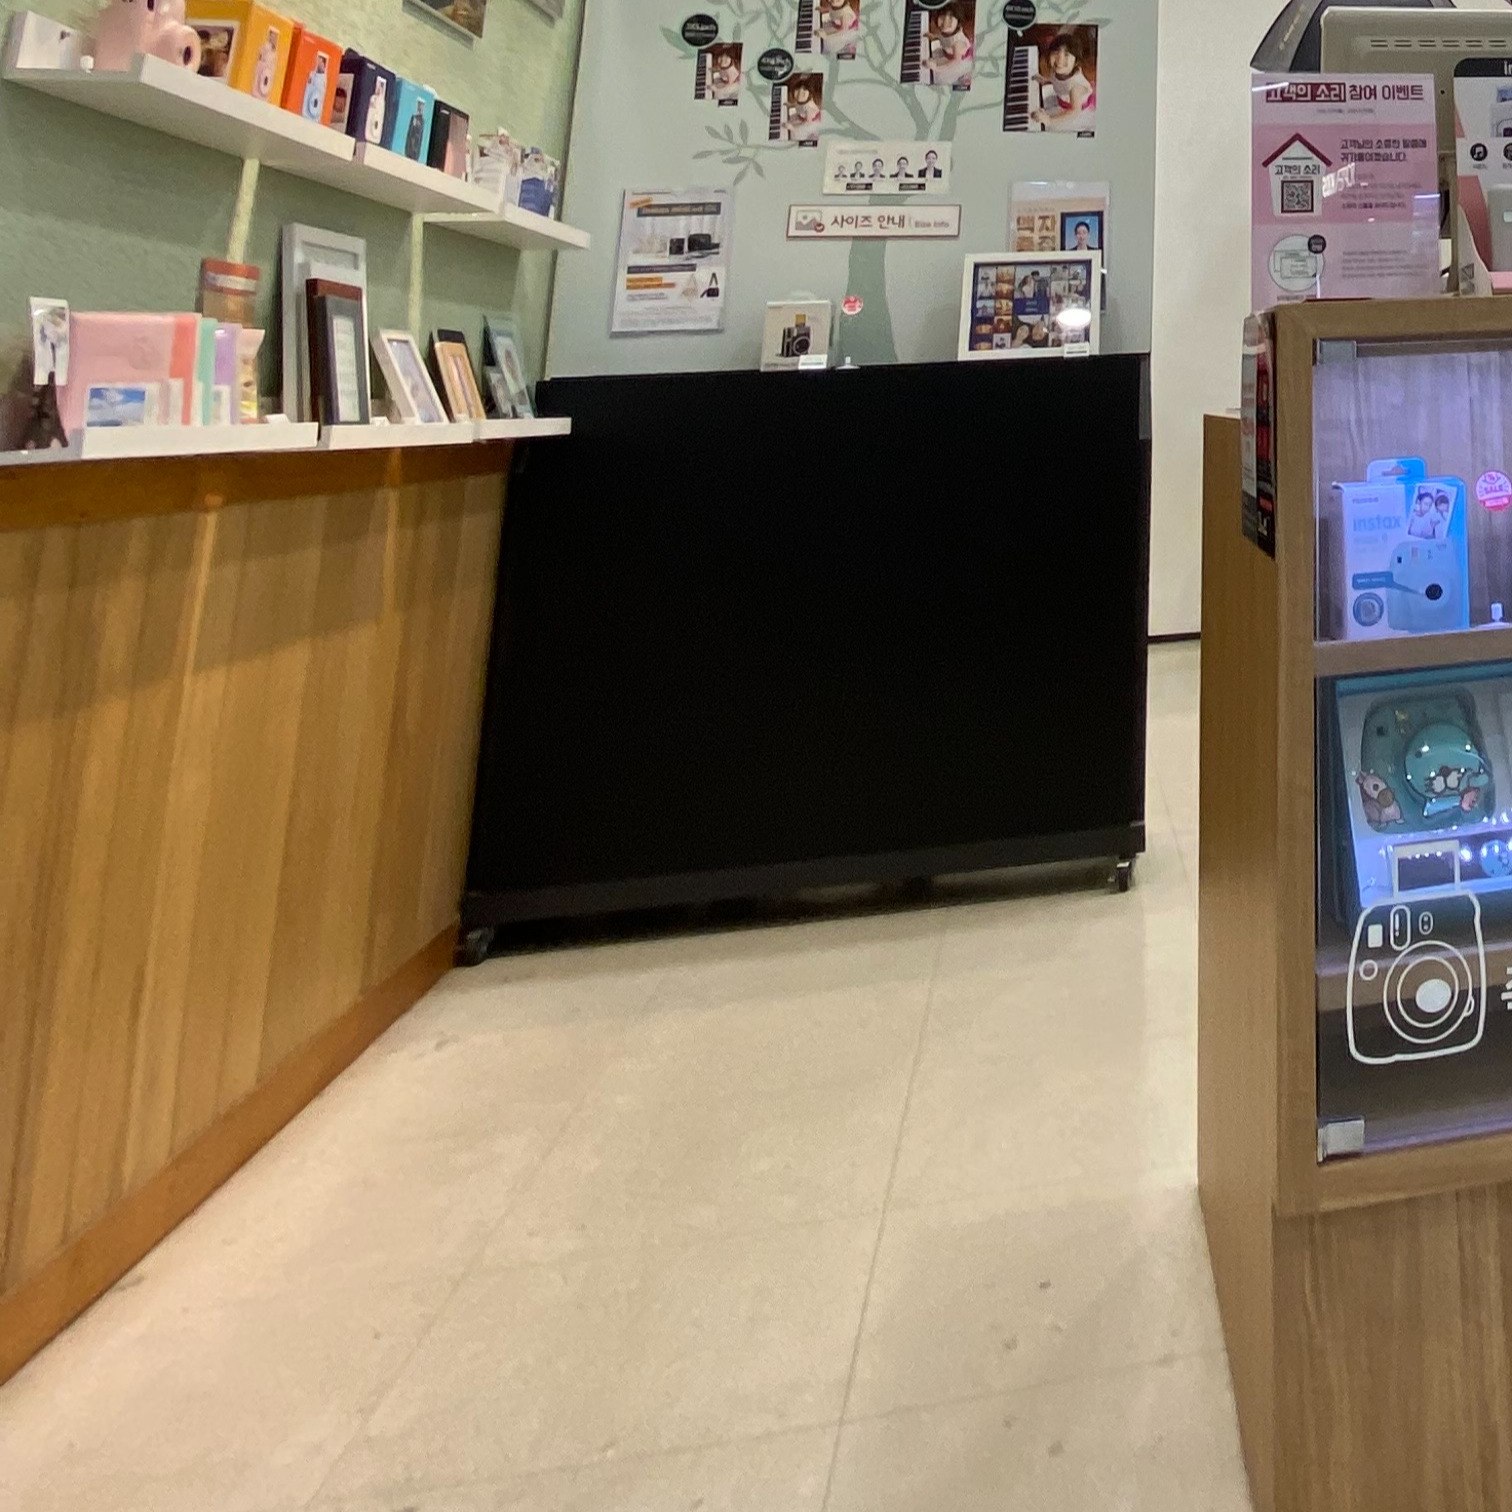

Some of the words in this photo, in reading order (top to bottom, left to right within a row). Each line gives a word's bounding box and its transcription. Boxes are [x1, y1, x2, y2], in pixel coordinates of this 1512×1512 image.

[1267, 84, 1312, 101] 고객의
[1315, 84, 1345, 101] 소리
[1349, 83, 1377, 101] 참여
[1381, 83, 1424, 101] 이벤트
[1275, 164, 1301, 176] 고객의
[1303, 164, 1321, 175] 소리
[831, 215, 874, 229] 사이즈
[877, 215, 906, 229] 안내
[1352, 513, 1402, 532] instax
